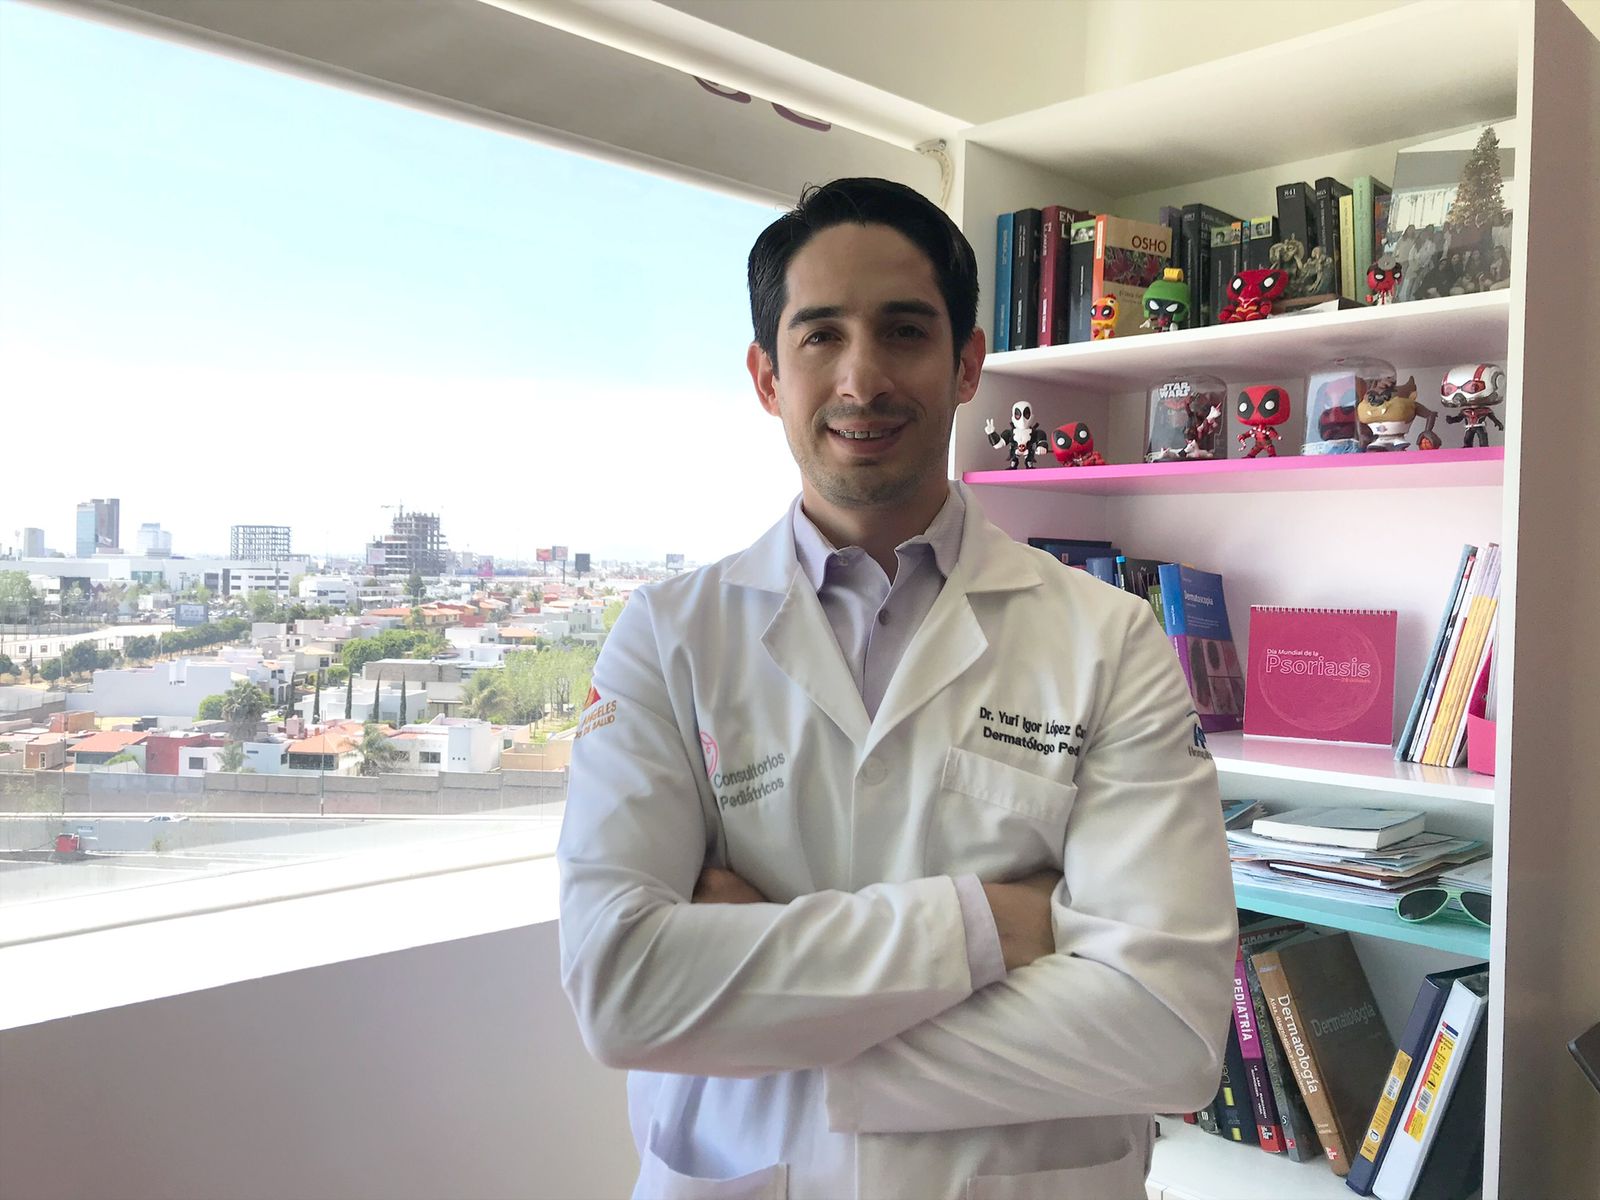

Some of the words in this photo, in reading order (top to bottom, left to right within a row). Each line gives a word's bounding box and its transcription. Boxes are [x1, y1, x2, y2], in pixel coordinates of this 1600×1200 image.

[1059, 211, 1074, 224] EN
[1132, 235, 1167, 253] OSHO
[1160, 389, 1190, 399] WARS
[1161, 382, 1190, 391] STAR
[1266, 654, 1371, 678] Psoriasis
[980, 706, 994, 721] Dr.
[999, 710, 1020, 727] Yuri
[1022, 717, 1042, 734] Igor
[1046, 719, 1071, 737] López
[983, 726, 1055, 755] Dermatólogo
[714, 752, 786, 789] Consultorios
[720, 777, 785, 811] Pediátricos
[1234, 978, 1254, 1041] PEDIATRÍA
[1278, 993, 1319, 1094] Dermatología
